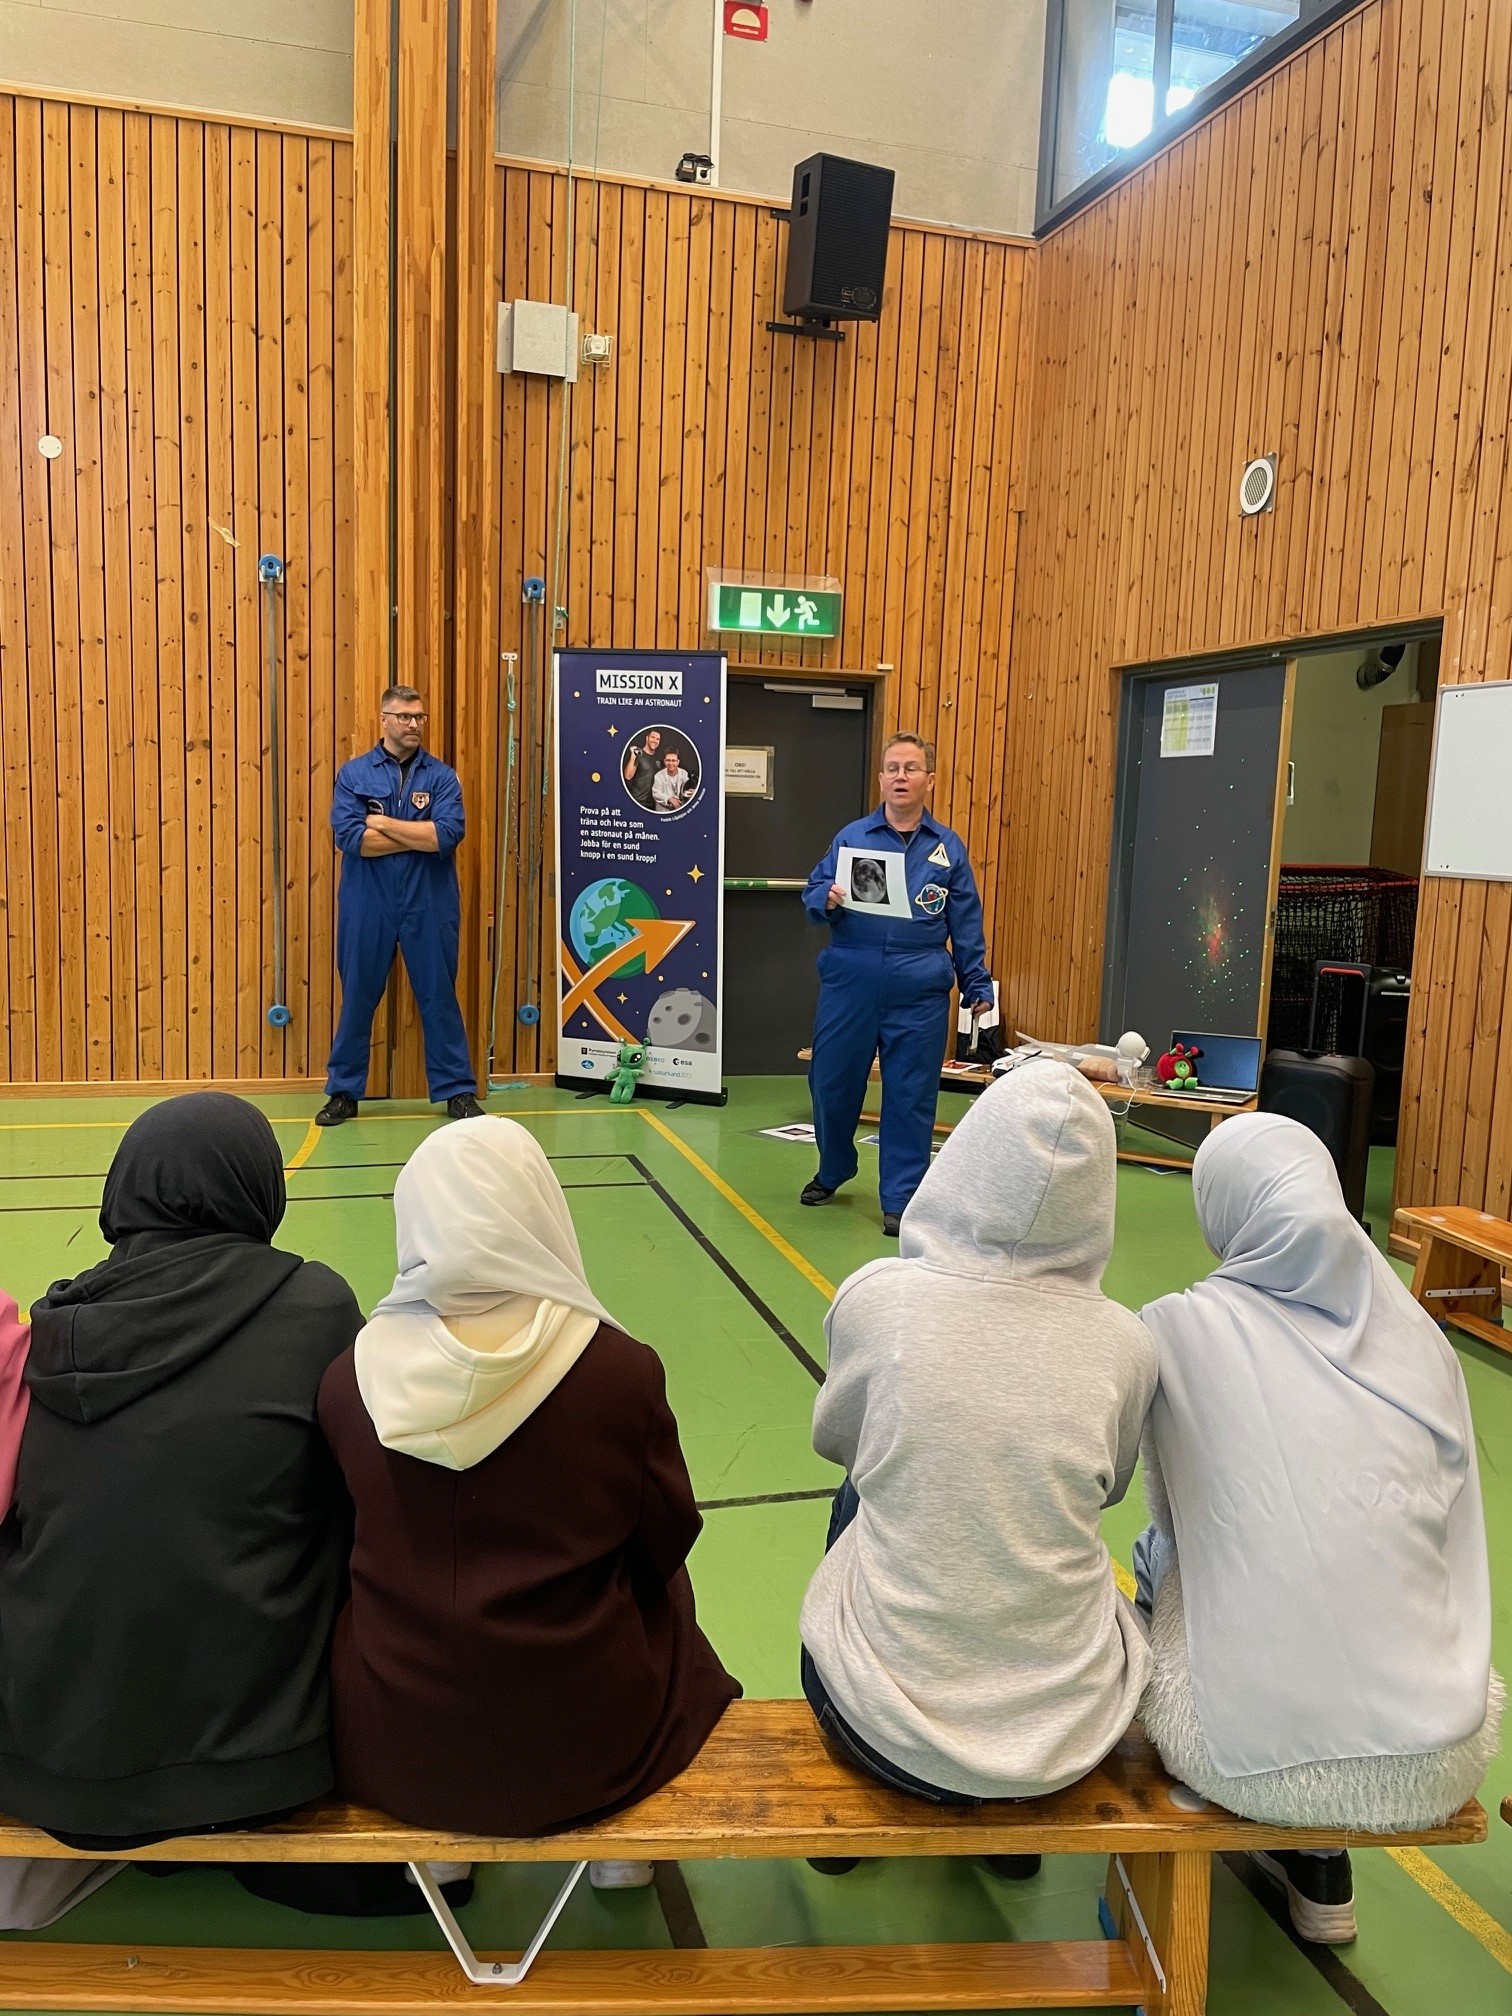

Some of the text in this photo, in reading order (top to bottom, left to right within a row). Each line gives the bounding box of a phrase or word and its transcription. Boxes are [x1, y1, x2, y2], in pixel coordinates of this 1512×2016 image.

[599, 674, 679, 690] MISSION X
[597, 697, 617, 705] TRAIN
[618, 698, 633, 706] LIKE
[645, 699, 682, 707] ASTRONAUT
[580, 806, 599, 815] Prova
[601, 807, 609, 816] på
[580, 818, 598, 826] träna
[599, 819, 611, 827] och
[613, 819, 627, 827] leva
[591, 830, 622, 838] astronaut
[624, 831, 633, 839] på
[635, 832, 660, 840] månen.
[580, 839, 600, 847] Jobba
[601, 840, 611, 848] för
[580, 850, 600, 859] knopp
[636, 854, 657, 863] kropp!
